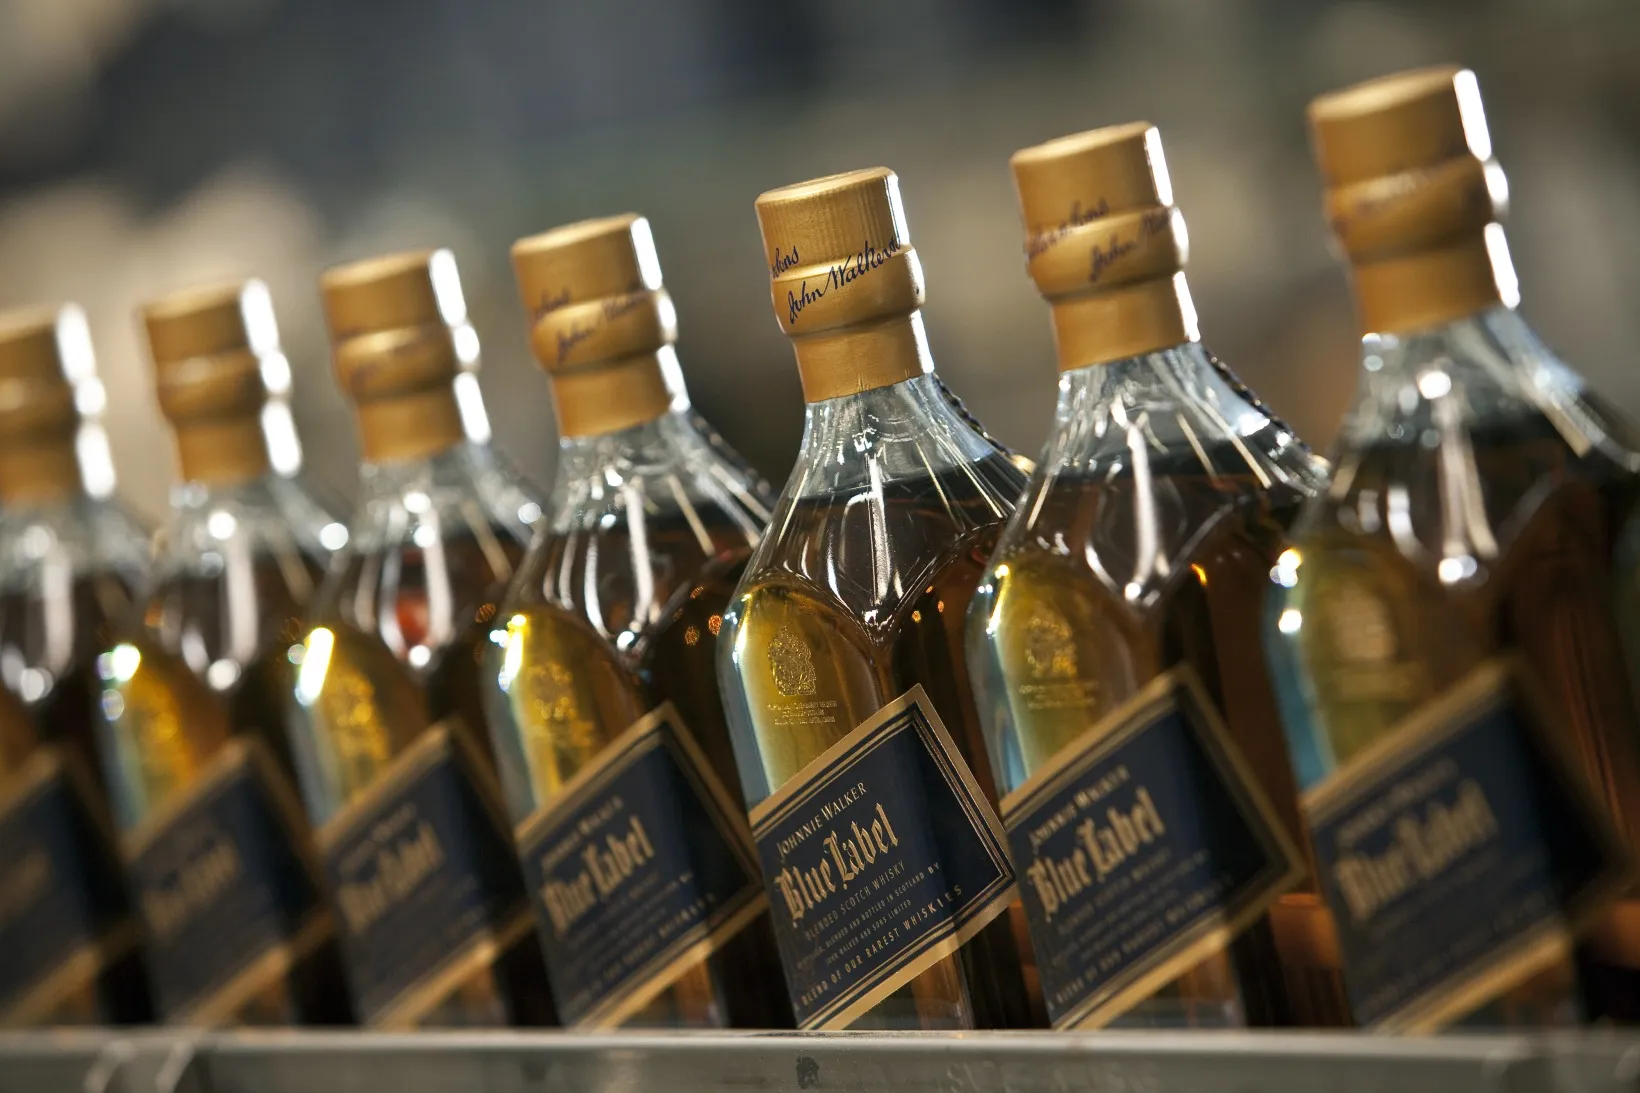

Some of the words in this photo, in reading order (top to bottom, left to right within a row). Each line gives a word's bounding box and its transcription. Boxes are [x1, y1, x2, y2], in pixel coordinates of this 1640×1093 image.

[787, 281, 825, 325] John
[776, 815, 823, 863] JOHNNIE
[820, 782, 867, 821] WALKER
[774, 857, 836, 928] Blue
[822, 802, 899, 890] Label
[840, 886, 871, 915] SCOTCH
[872, 861, 905, 890] WHISKY
[861, 899, 886, 921] BOTTLED
[894, 872, 925, 897] SCOTLAND
[927, 862, 939, 874] BY
[844, 954, 863, 974] OUR
[865, 926, 900, 958] RAREST
[903, 884, 962, 931] WHISKIES
[872, 916, 887, 931] SONS
[888, 899, 911, 919] LIMITED
